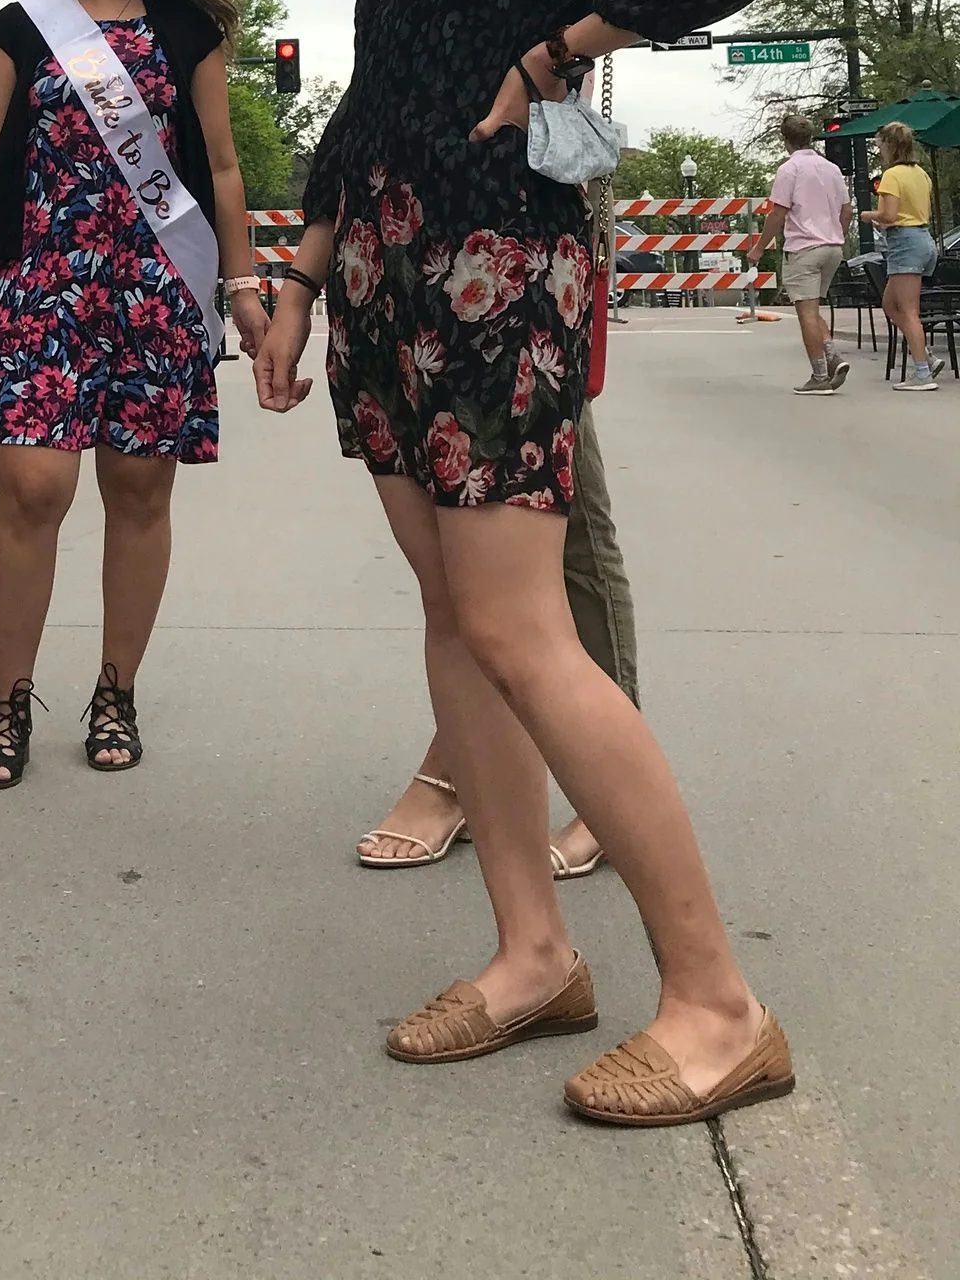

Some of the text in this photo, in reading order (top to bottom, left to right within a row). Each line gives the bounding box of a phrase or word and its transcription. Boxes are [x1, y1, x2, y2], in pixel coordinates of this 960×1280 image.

[688, 36, 705, 45] WAY
[750, 47, 783, 61] 14th
[117, 129, 143, 170] to
[136, 169, 172, 220] Be
